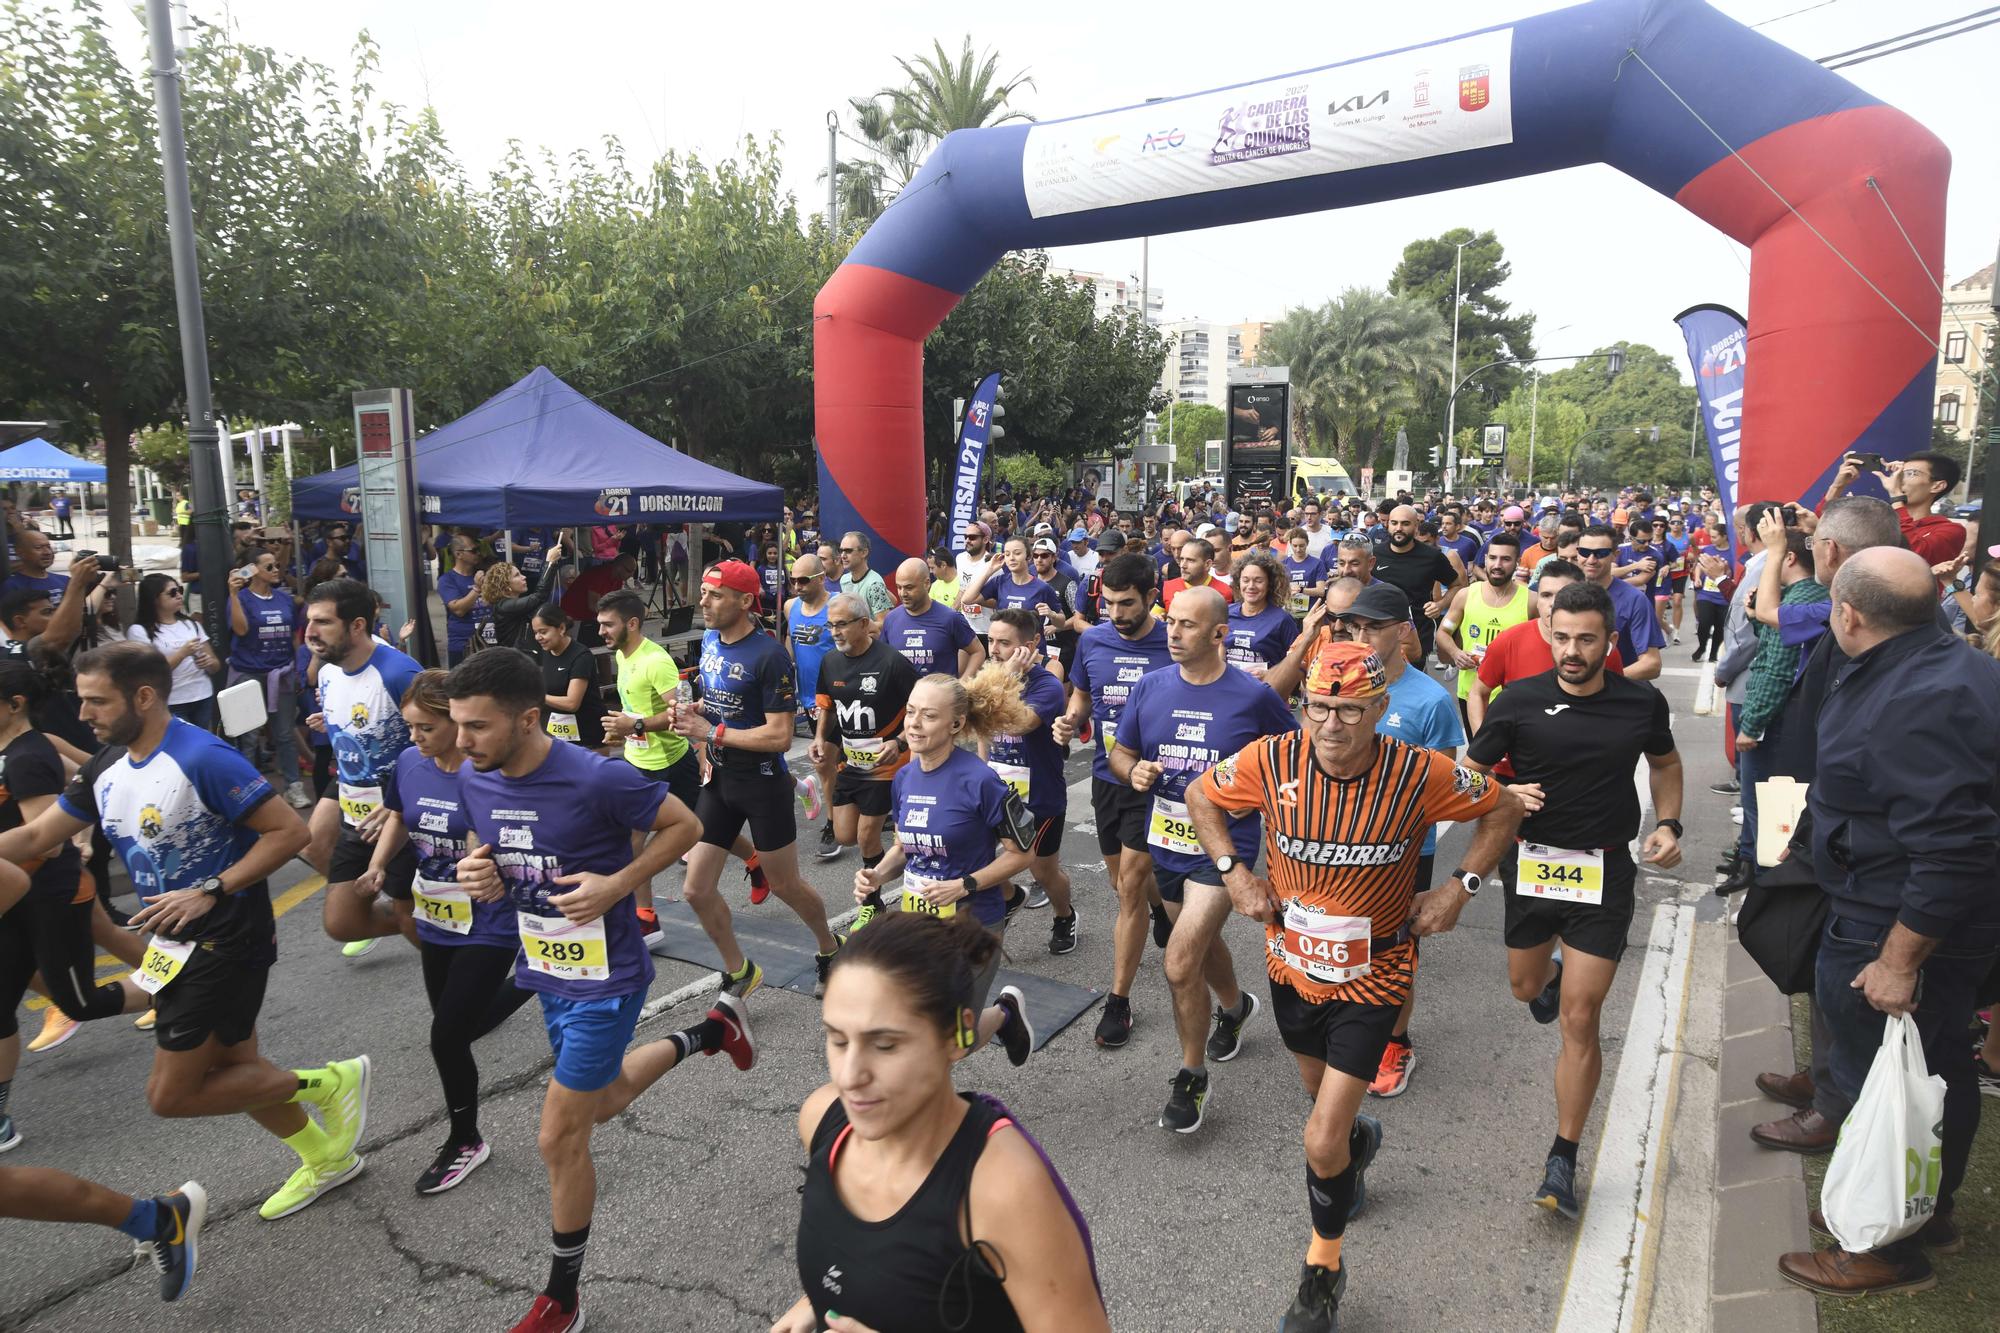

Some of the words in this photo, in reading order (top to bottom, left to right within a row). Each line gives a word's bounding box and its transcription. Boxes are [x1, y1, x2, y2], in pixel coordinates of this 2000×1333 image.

[1247, 95, 1308, 118] CARRERA
[1328, 90, 1389, 115] KIA
[1265, 114, 1282, 129] DE
[1284, 108, 1309, 126] LAS
[1244, 123, 1310, 148] CIUDADES
[1214, 153, 1236, 164] CONTRA
[1236, 152, 1244, 160] EL
[1268, 146, 1277, 154] DE
[1712, 328, 1746, 354] DORSAL
[1720, 340, 1746, 375] 21
[640, 495, 724, 512] DORSAL21.COM
[952, 437, 983, 551] DORSAL21
[608, 496, 628, 516] 21
[702, 652, 724, 674] 764
[1102, 695, 1127, 705] CORRO
[1103, 686, 1129, 696] CORRO
[552, 725, 570, 734] 286
[850, 750, 874, 761] 332
[1159, 744, 1188, 758] CORRO
[1190, 747, 1208, 760] POR
[1210, 750, 1219, 762] TI
[1158, 756, 1186, 770] CORRO
[1186, 758, 1205, 772] POR
[348, 802, 371, 815] 149
[1164, 819, 1197, 840] 295
[436, 837, 454, 849] POR
[916, 833, 932, 846] POR
[545, 856, 558, 868] TI
[1537, 864, 1583, 883] 344
[422, 899, 453, 918] 271
[538, 940, 584, 961] 289
[1298, 936, 1349, 963] 046
[147, 951, 174, 977] 364
[1314, 964, 1334, 972] KIA
